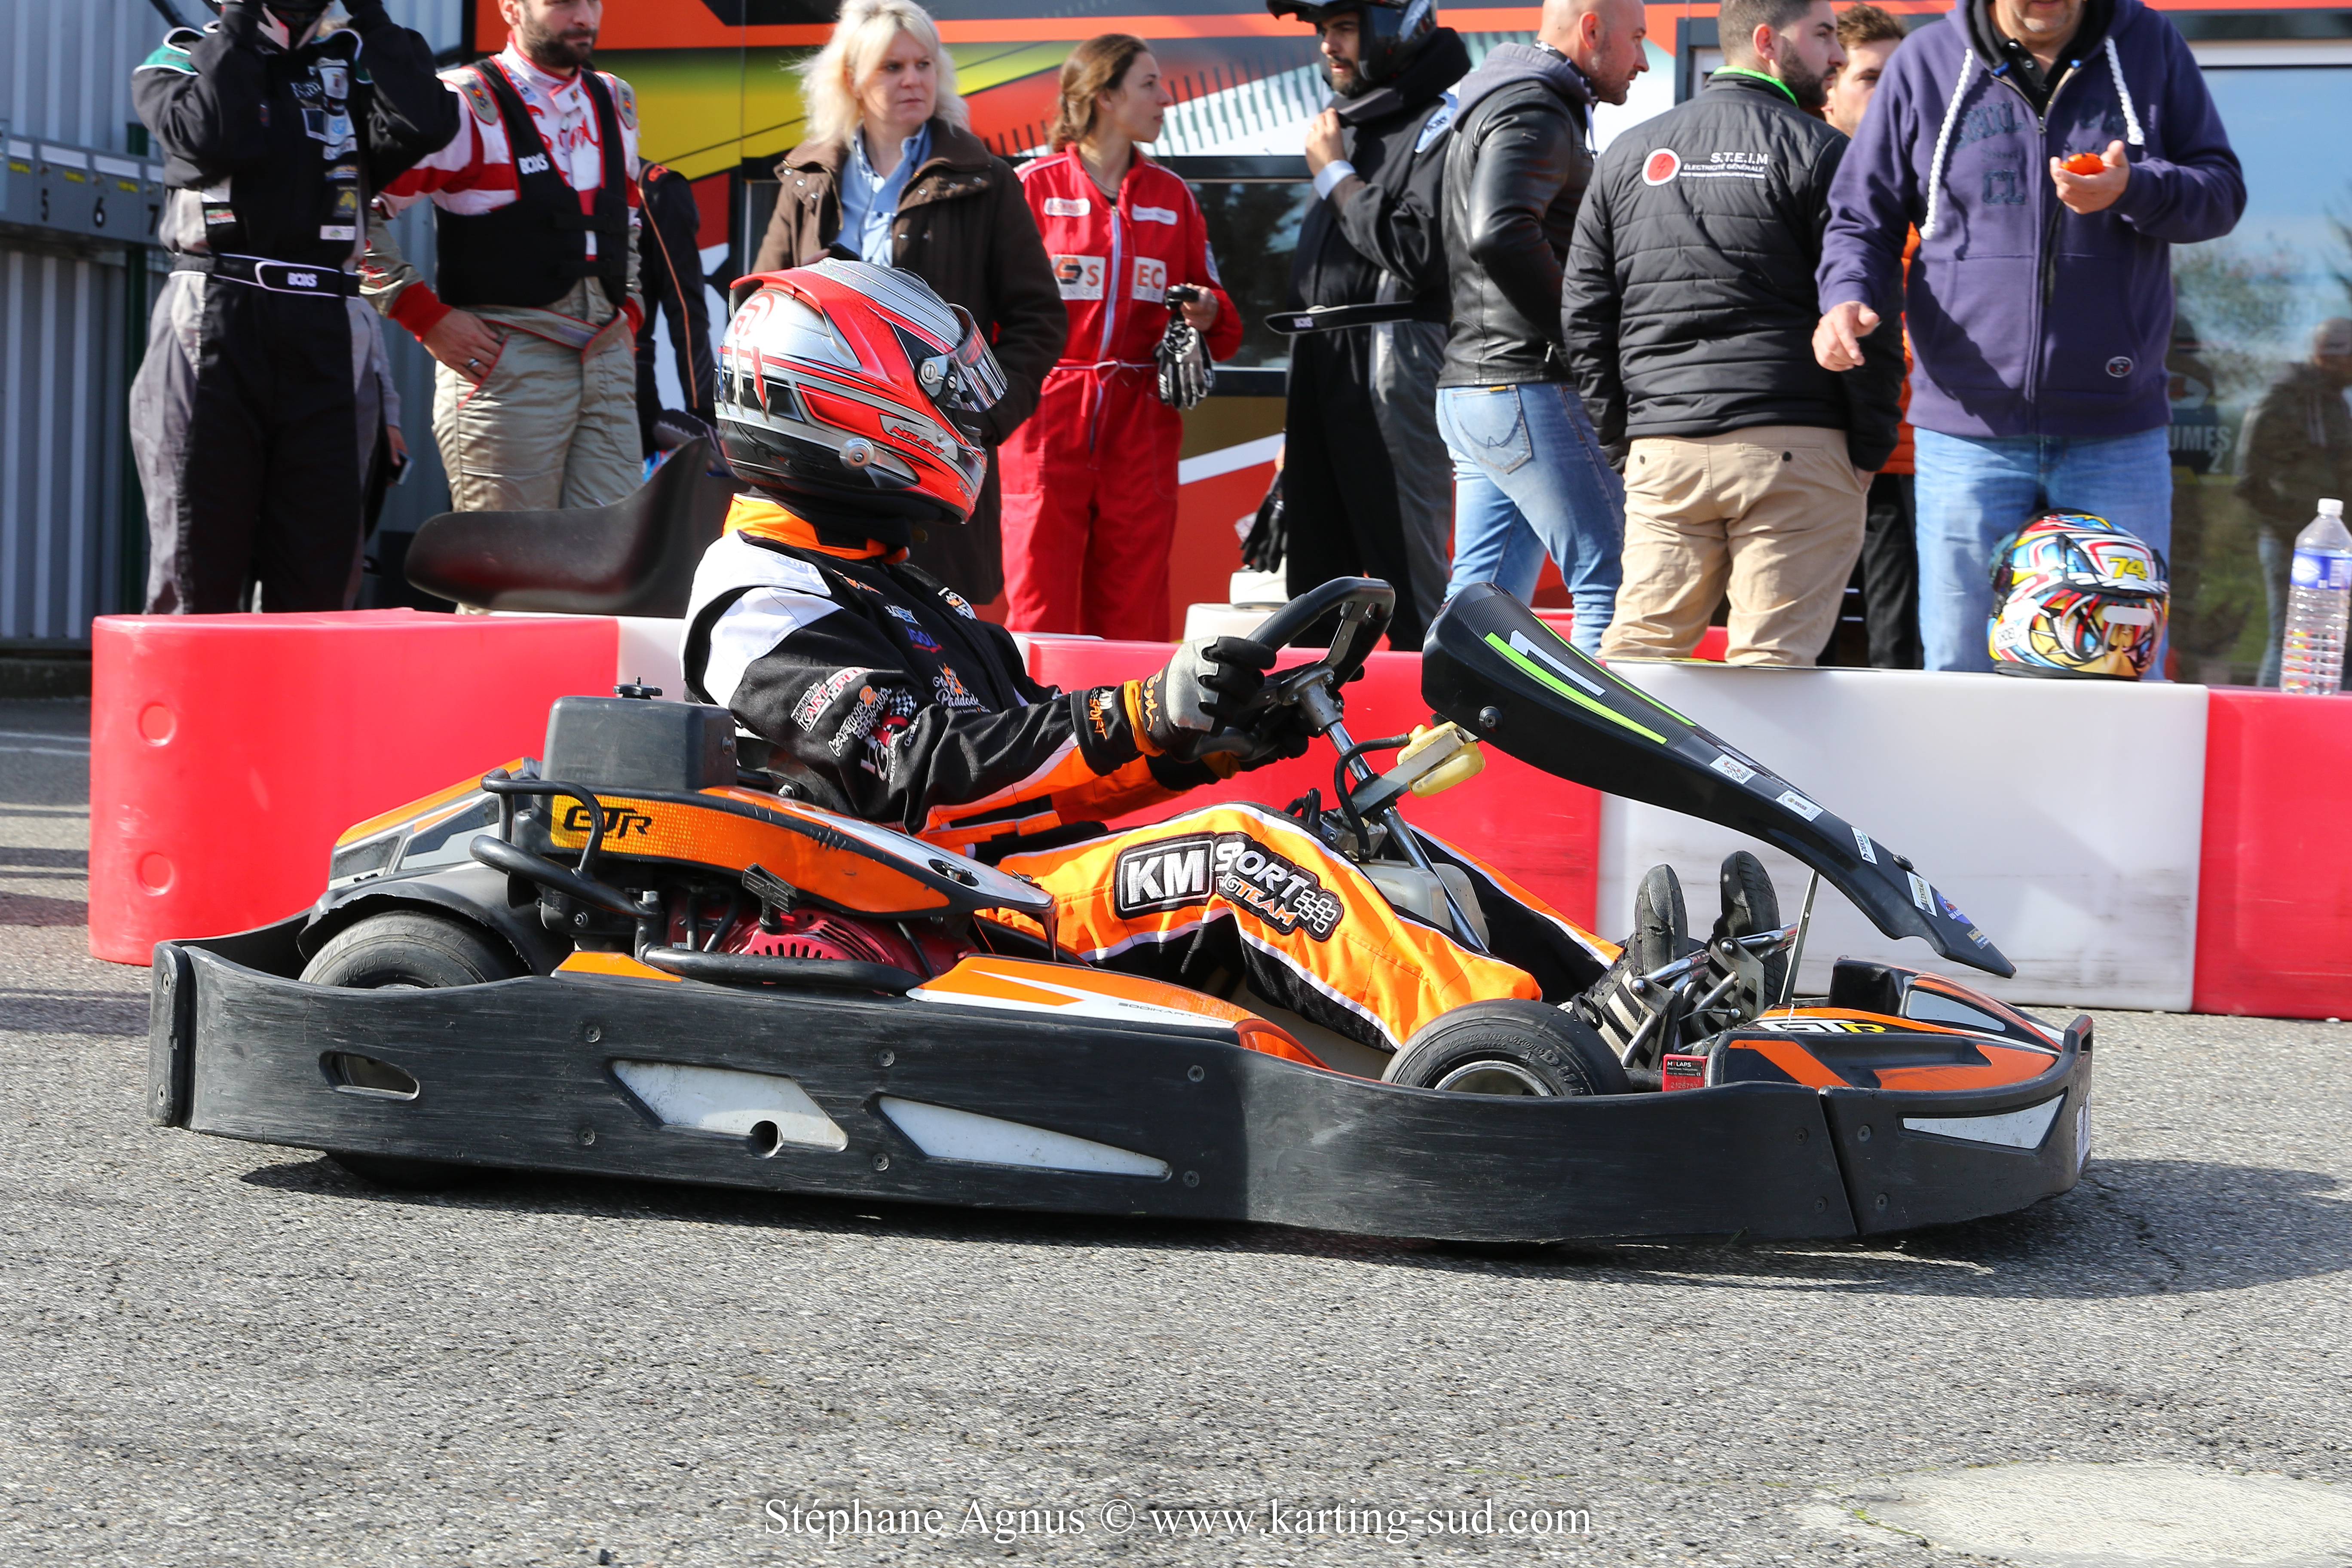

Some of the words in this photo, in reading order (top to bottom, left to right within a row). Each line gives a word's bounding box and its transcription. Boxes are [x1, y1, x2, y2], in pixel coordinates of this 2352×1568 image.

[1710, 152, 1769, 165] S.T.E.I.M
[94, 196, 105, 229] 6
[148, 204, 160, 236] 7
[2108, 557, 2148, 581] 74
[798, 683, 829, 731] KART
[1127, 849, 1205, 905] KM
[1215, 841, 1311, 899] SPORT
[1756, 1020, 1887, 1033] GTR
